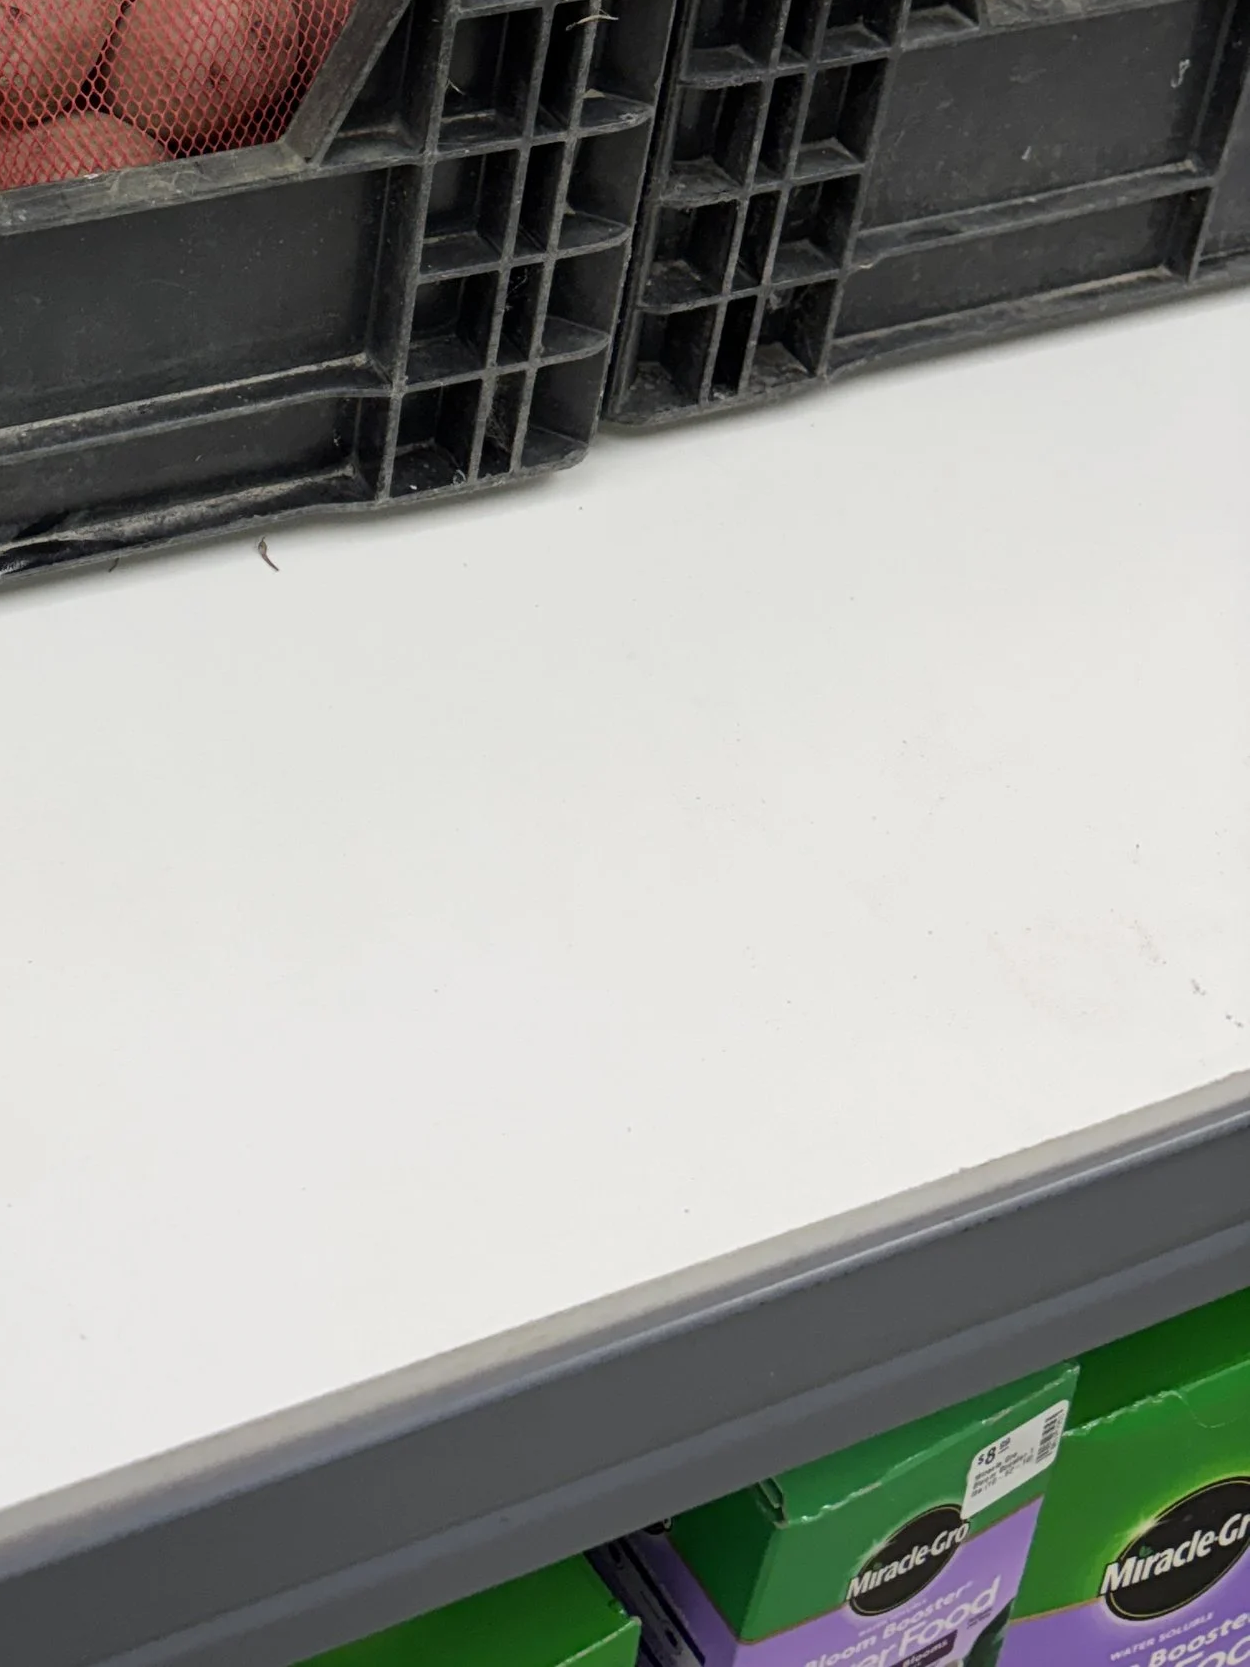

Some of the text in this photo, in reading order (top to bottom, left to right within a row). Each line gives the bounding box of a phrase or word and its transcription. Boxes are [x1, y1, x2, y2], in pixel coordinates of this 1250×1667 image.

[847, 1522, 969, 1600] Miracle-Gro
[803, 1635, 877, 1667] Bloom
[882, 1588, 961, 1639] Booster
[899, 1574, 1000, 1658] Food
[1111, 1612, 1214, 1661] WATER SOLUBLE
